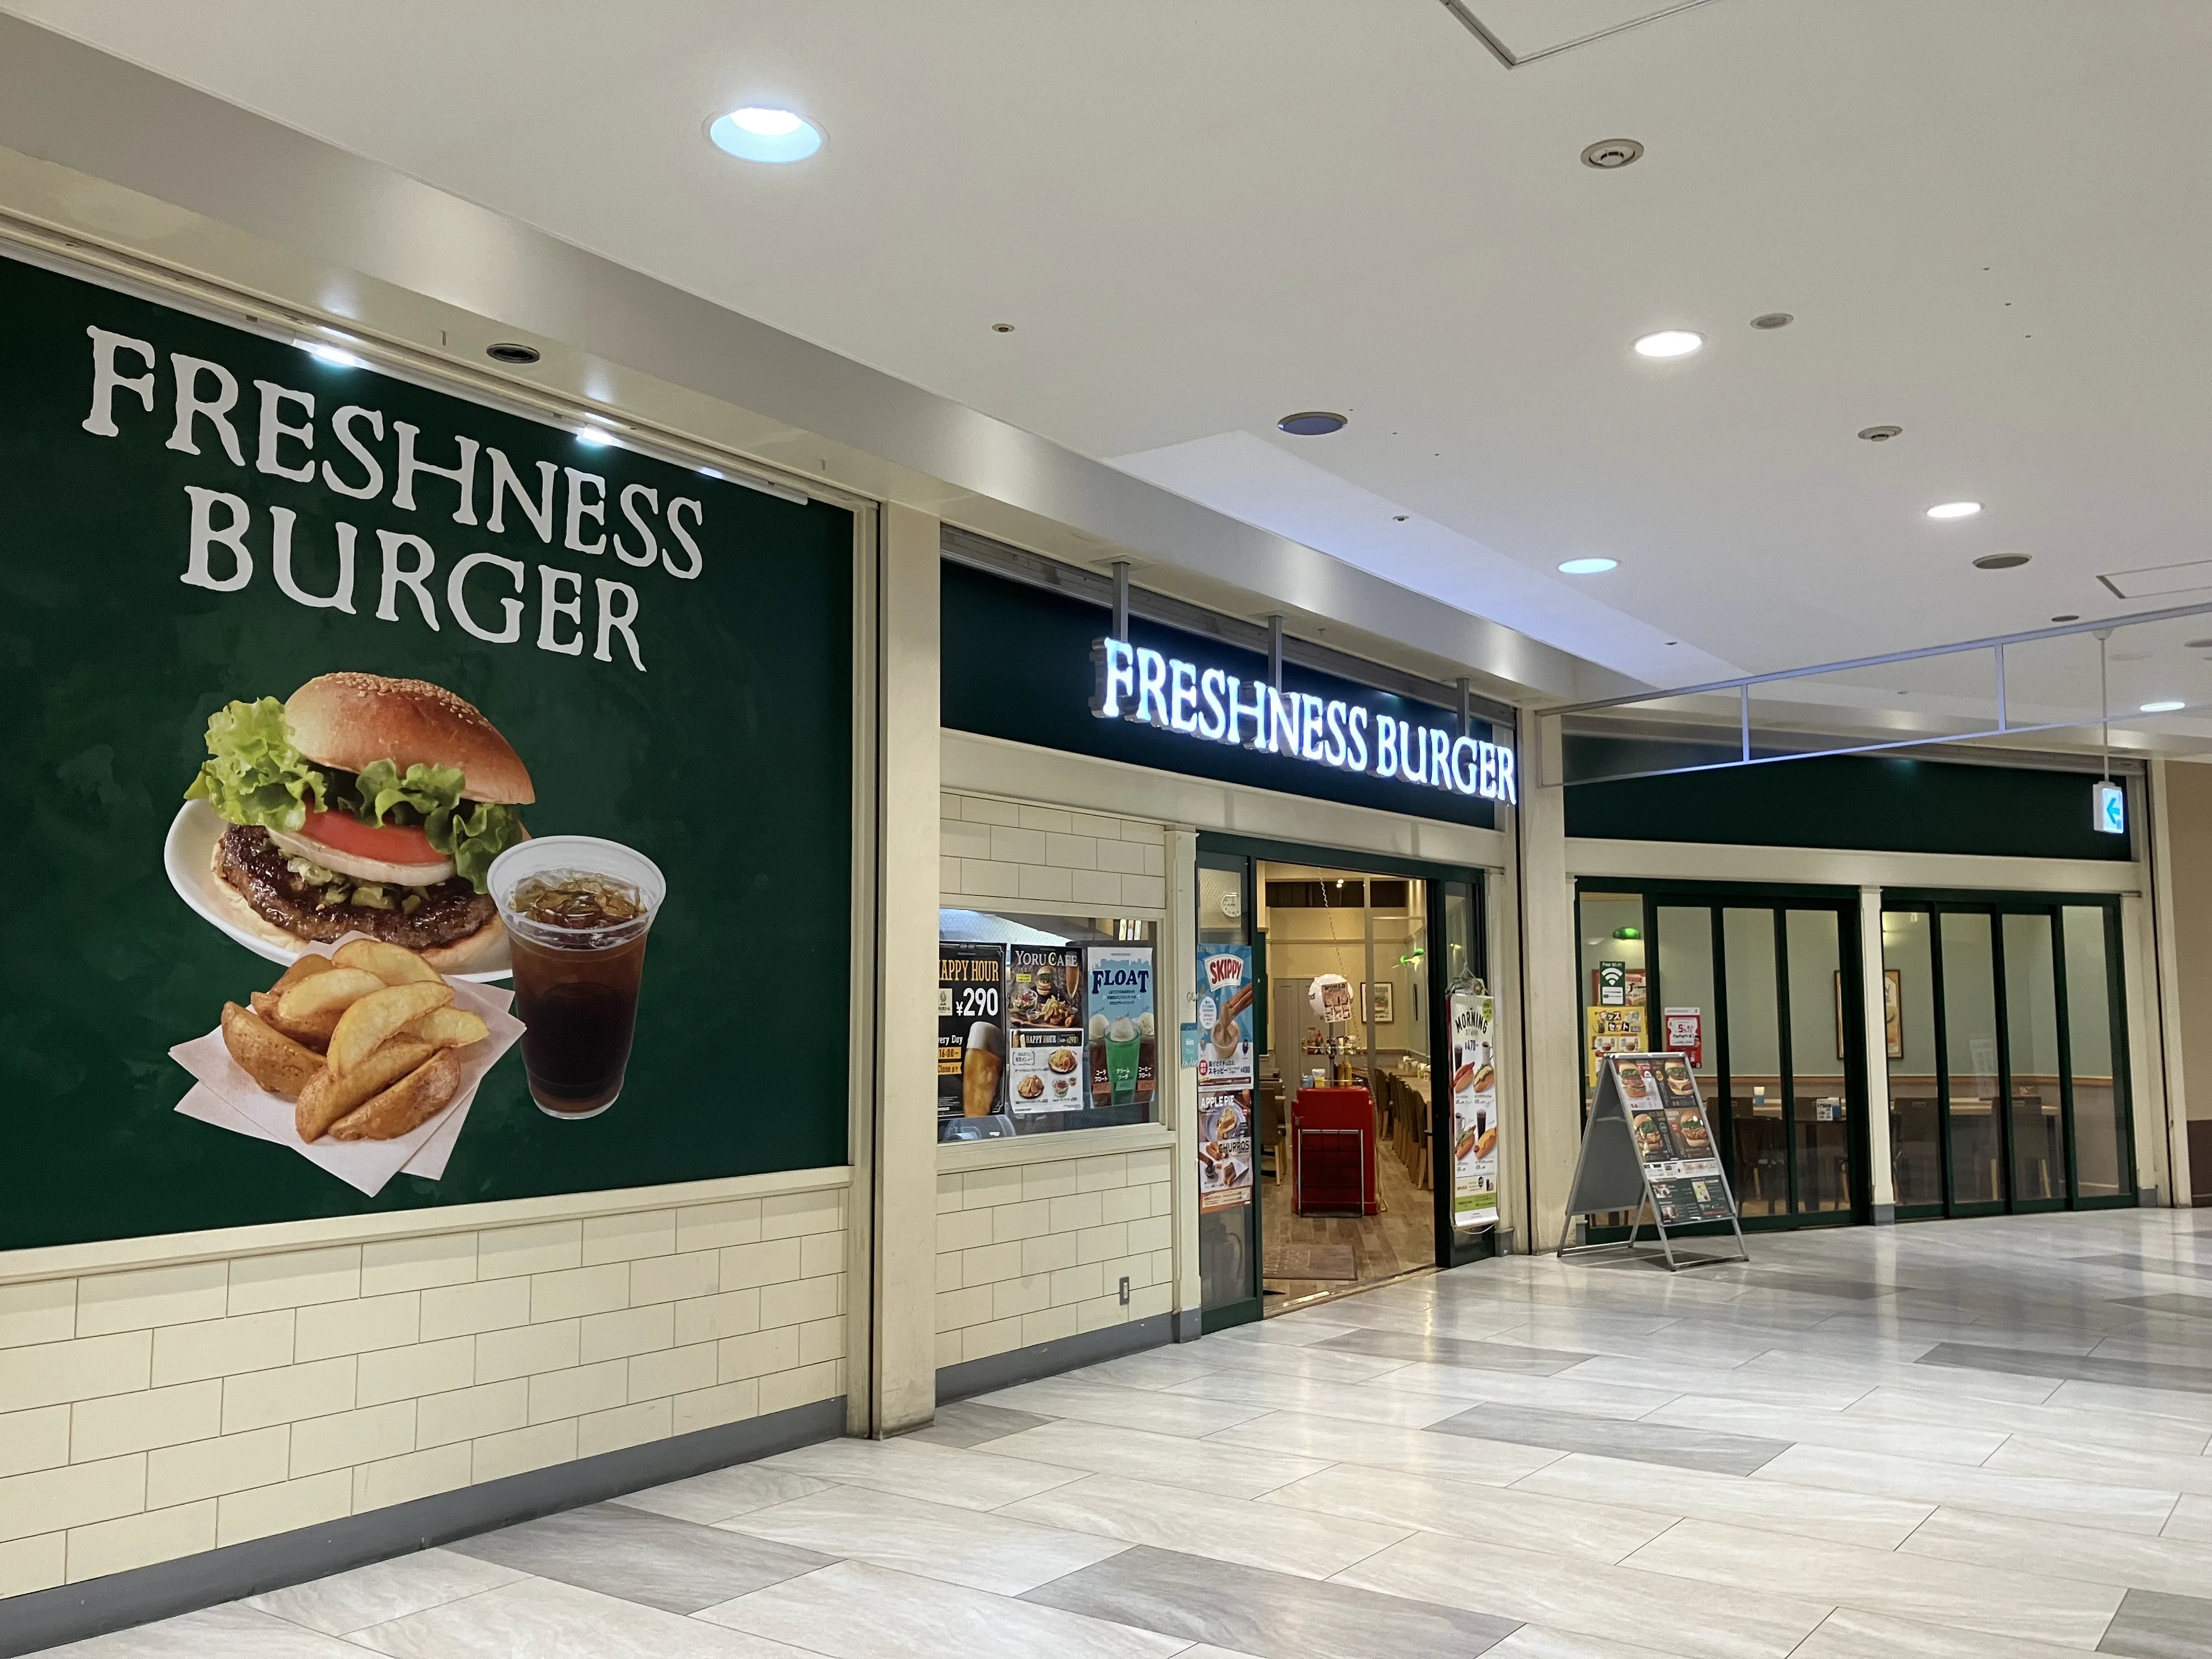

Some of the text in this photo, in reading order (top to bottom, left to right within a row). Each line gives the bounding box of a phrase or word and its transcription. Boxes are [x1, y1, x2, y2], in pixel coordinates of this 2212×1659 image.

[82, 325, 703, 579] FRESHNESS
[180, 486, 647, 672] BURGER
[1098, 636, 1517, 805] FRESHNESS BURGER
[1015, 950, 1047, 966] YORU
[939, 959, 1000, 982] APPY HOUR
[1092, 969, 1149, 994] FLOAT
[1210, 958, 1242, 984] SKIPPY
[955, 988, 999, 1016] ¥290
[1455, 1011, 1488, 1034] MORNING
[951, 1035, 963, 1046] Day
[1025, 1035, 1042, 1043] HAPPY
[1201, 1094, 1235, 1108] APPLE PIE
[1218, 1141, 1250, 1154] CHURROS
